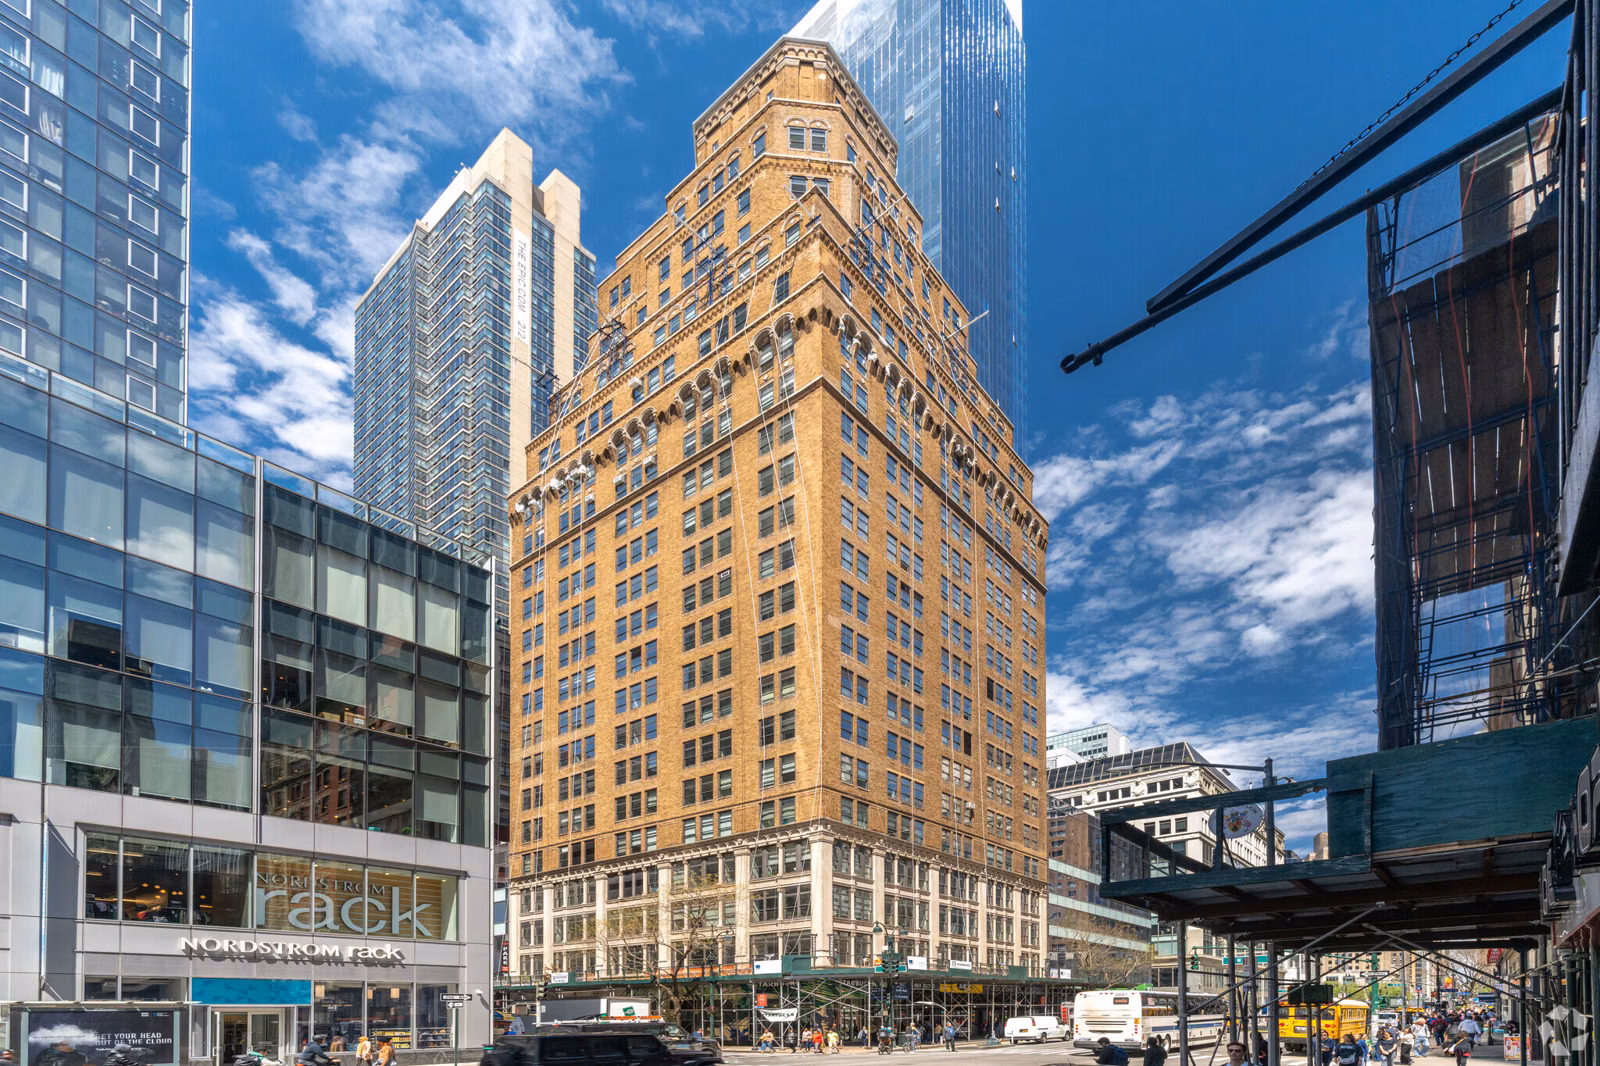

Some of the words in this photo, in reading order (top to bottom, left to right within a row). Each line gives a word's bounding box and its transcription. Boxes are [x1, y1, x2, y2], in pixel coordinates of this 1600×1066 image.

[517, 239, 527, 262] THE
[517, 319, 527, 340] 212
[256, 886, 433, 937] rack
[179, 936, 340, 957] NORDSTROM
[347, 943, 402, 960] rack
